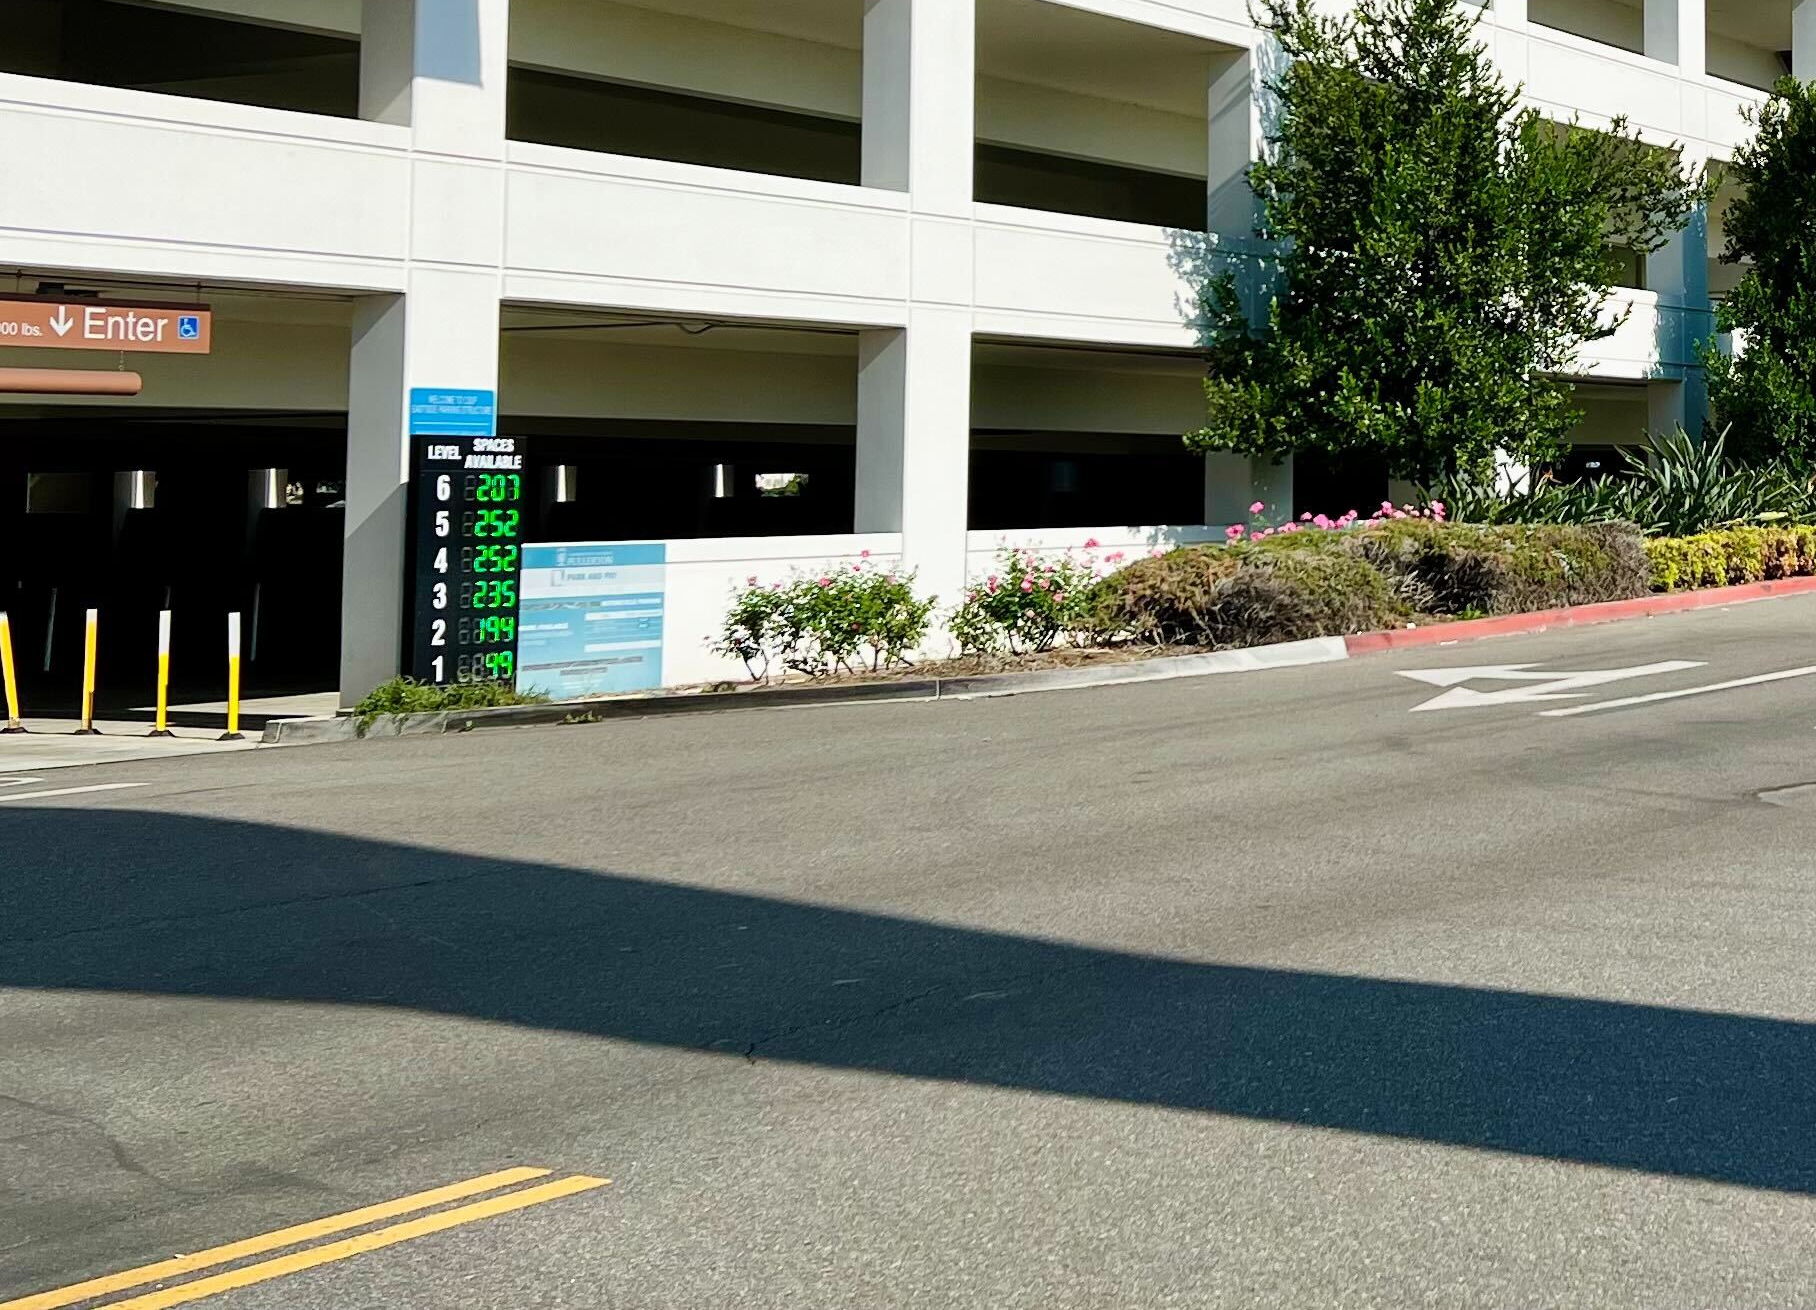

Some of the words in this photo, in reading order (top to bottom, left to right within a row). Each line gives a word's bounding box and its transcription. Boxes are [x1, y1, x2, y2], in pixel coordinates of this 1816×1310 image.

[0, 321, 18, 336] 00
[21, 322, 43, 337] lbs.
[84, 306, 169, 342] Enter
[427, 444, 462, 460] LEVEL
[473, 438, 515, 453] SPACES
[464, 454, 522, 469] AVAILABLE
[436, 474, 451, 501] 6
[476, 473, 520, 502] 207
[435, 510, 450, 537] 5
[474, 509, 519, 537] 252
[433, 547, 448, 574] 4
[473, 545, 518, 572] 252
[432, 582, 448, 609] 3
[473, 579, 516, 608] 235
[431, 618, 446, 646] 2
[480, 616, 514, 642] 194
[431, 655, 444, 682] 1
[485, 650, 513, 680] 99
